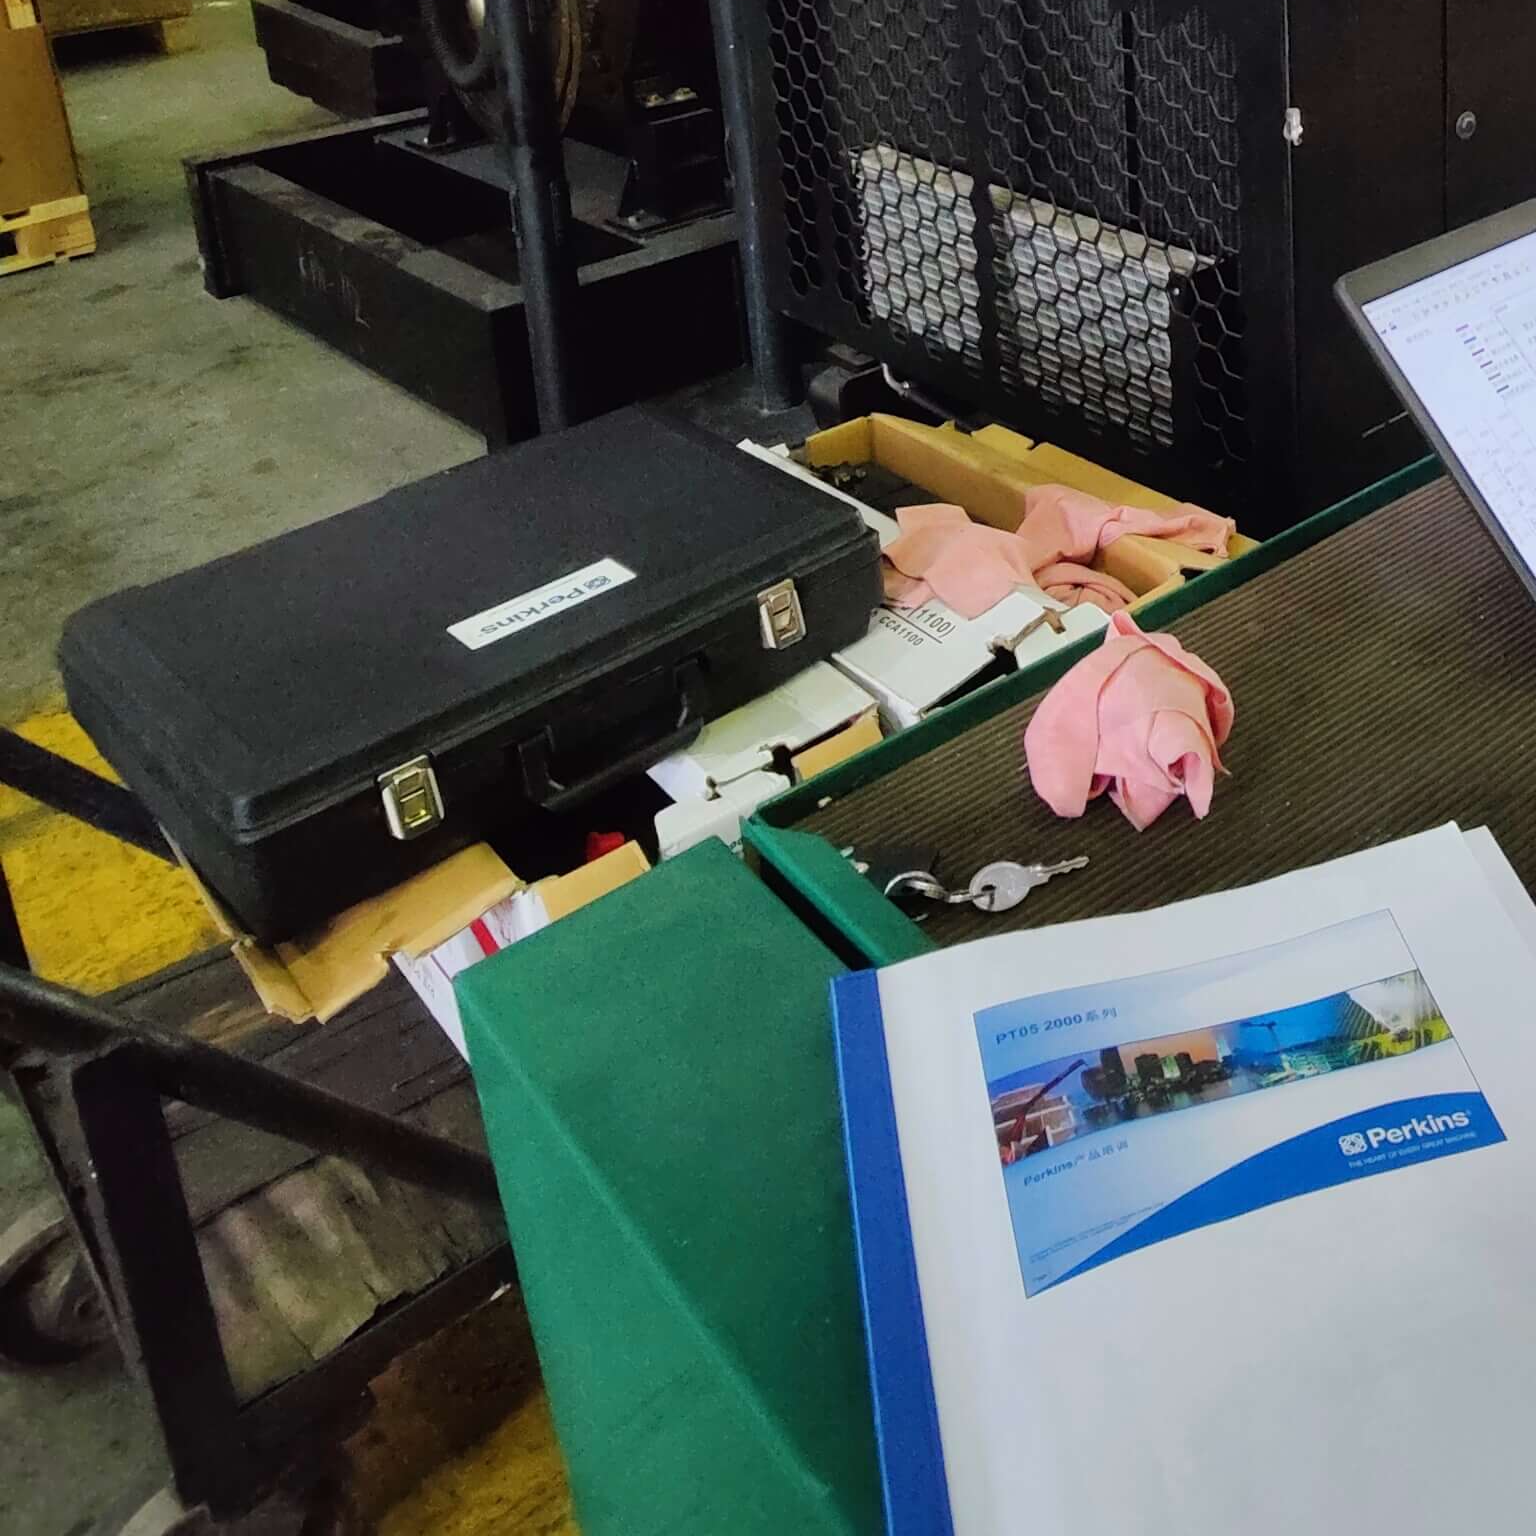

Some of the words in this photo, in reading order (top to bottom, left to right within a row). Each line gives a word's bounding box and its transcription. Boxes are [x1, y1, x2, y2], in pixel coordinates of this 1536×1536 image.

[479, 587, 585, 636] Perkins
[879, 615, 925, 647] CCA1100
[1365, 1111, 1471, 1149] Perkins
